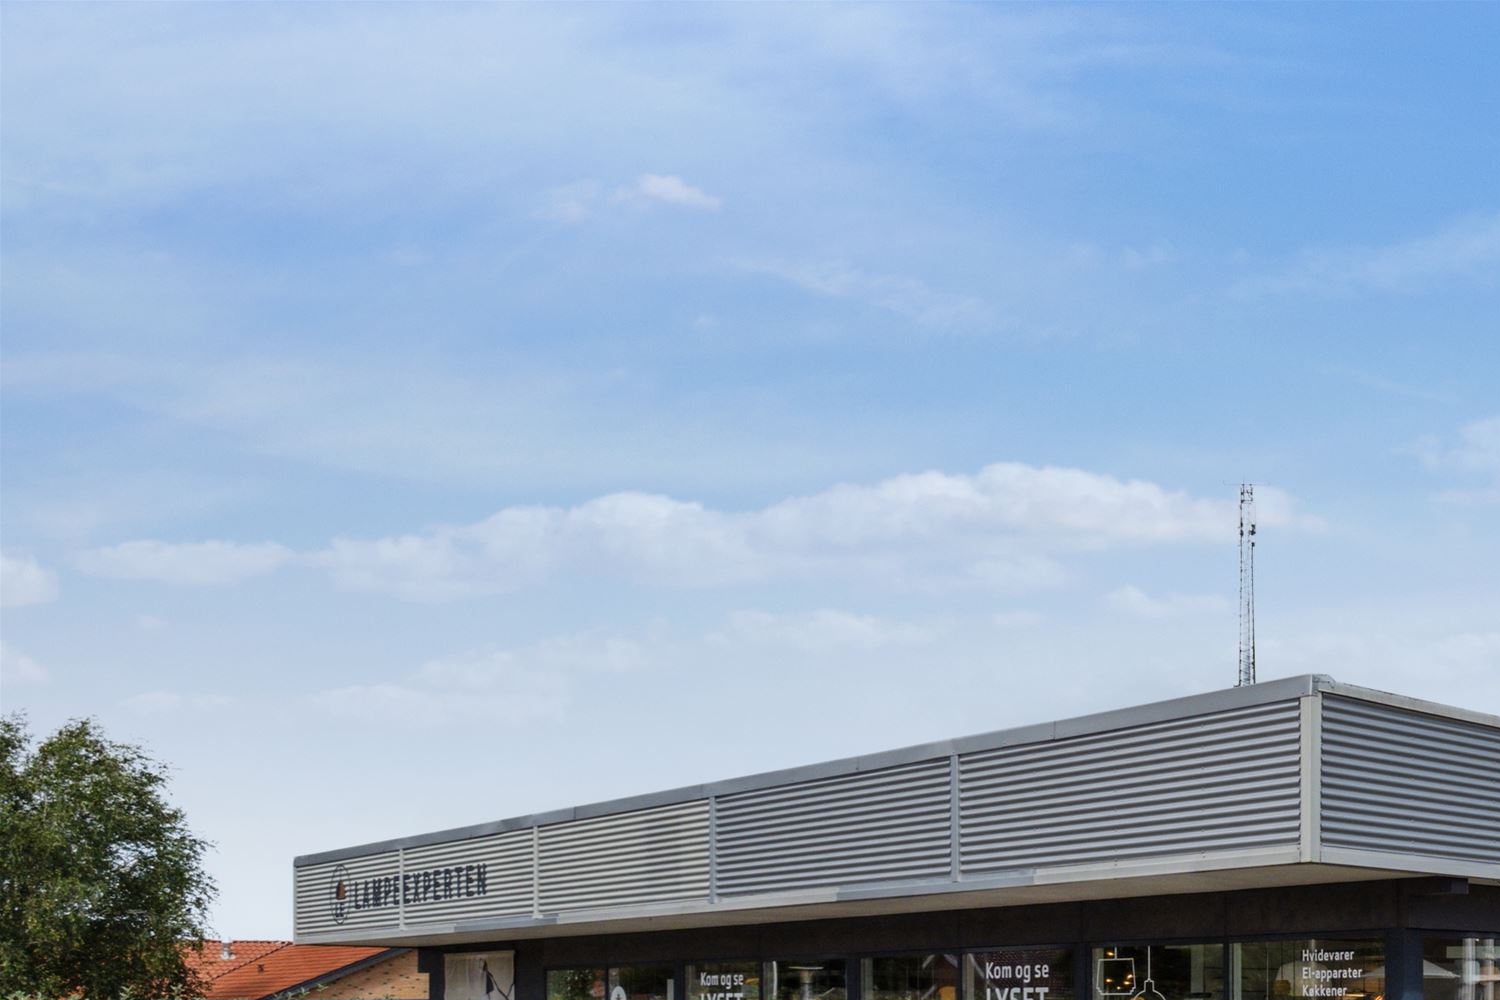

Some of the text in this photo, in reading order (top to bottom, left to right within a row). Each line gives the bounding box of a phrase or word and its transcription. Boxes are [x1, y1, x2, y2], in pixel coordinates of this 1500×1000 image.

[1302, 949, 1355, 962] Hvidevarer
[986, 962, 1049, 983] Kom og se
[1302, 967, 1363, 982] El-apparater
[700, 972, 744, 990] Kom og se
[1302, 984, 1348, 997] Køkkener
